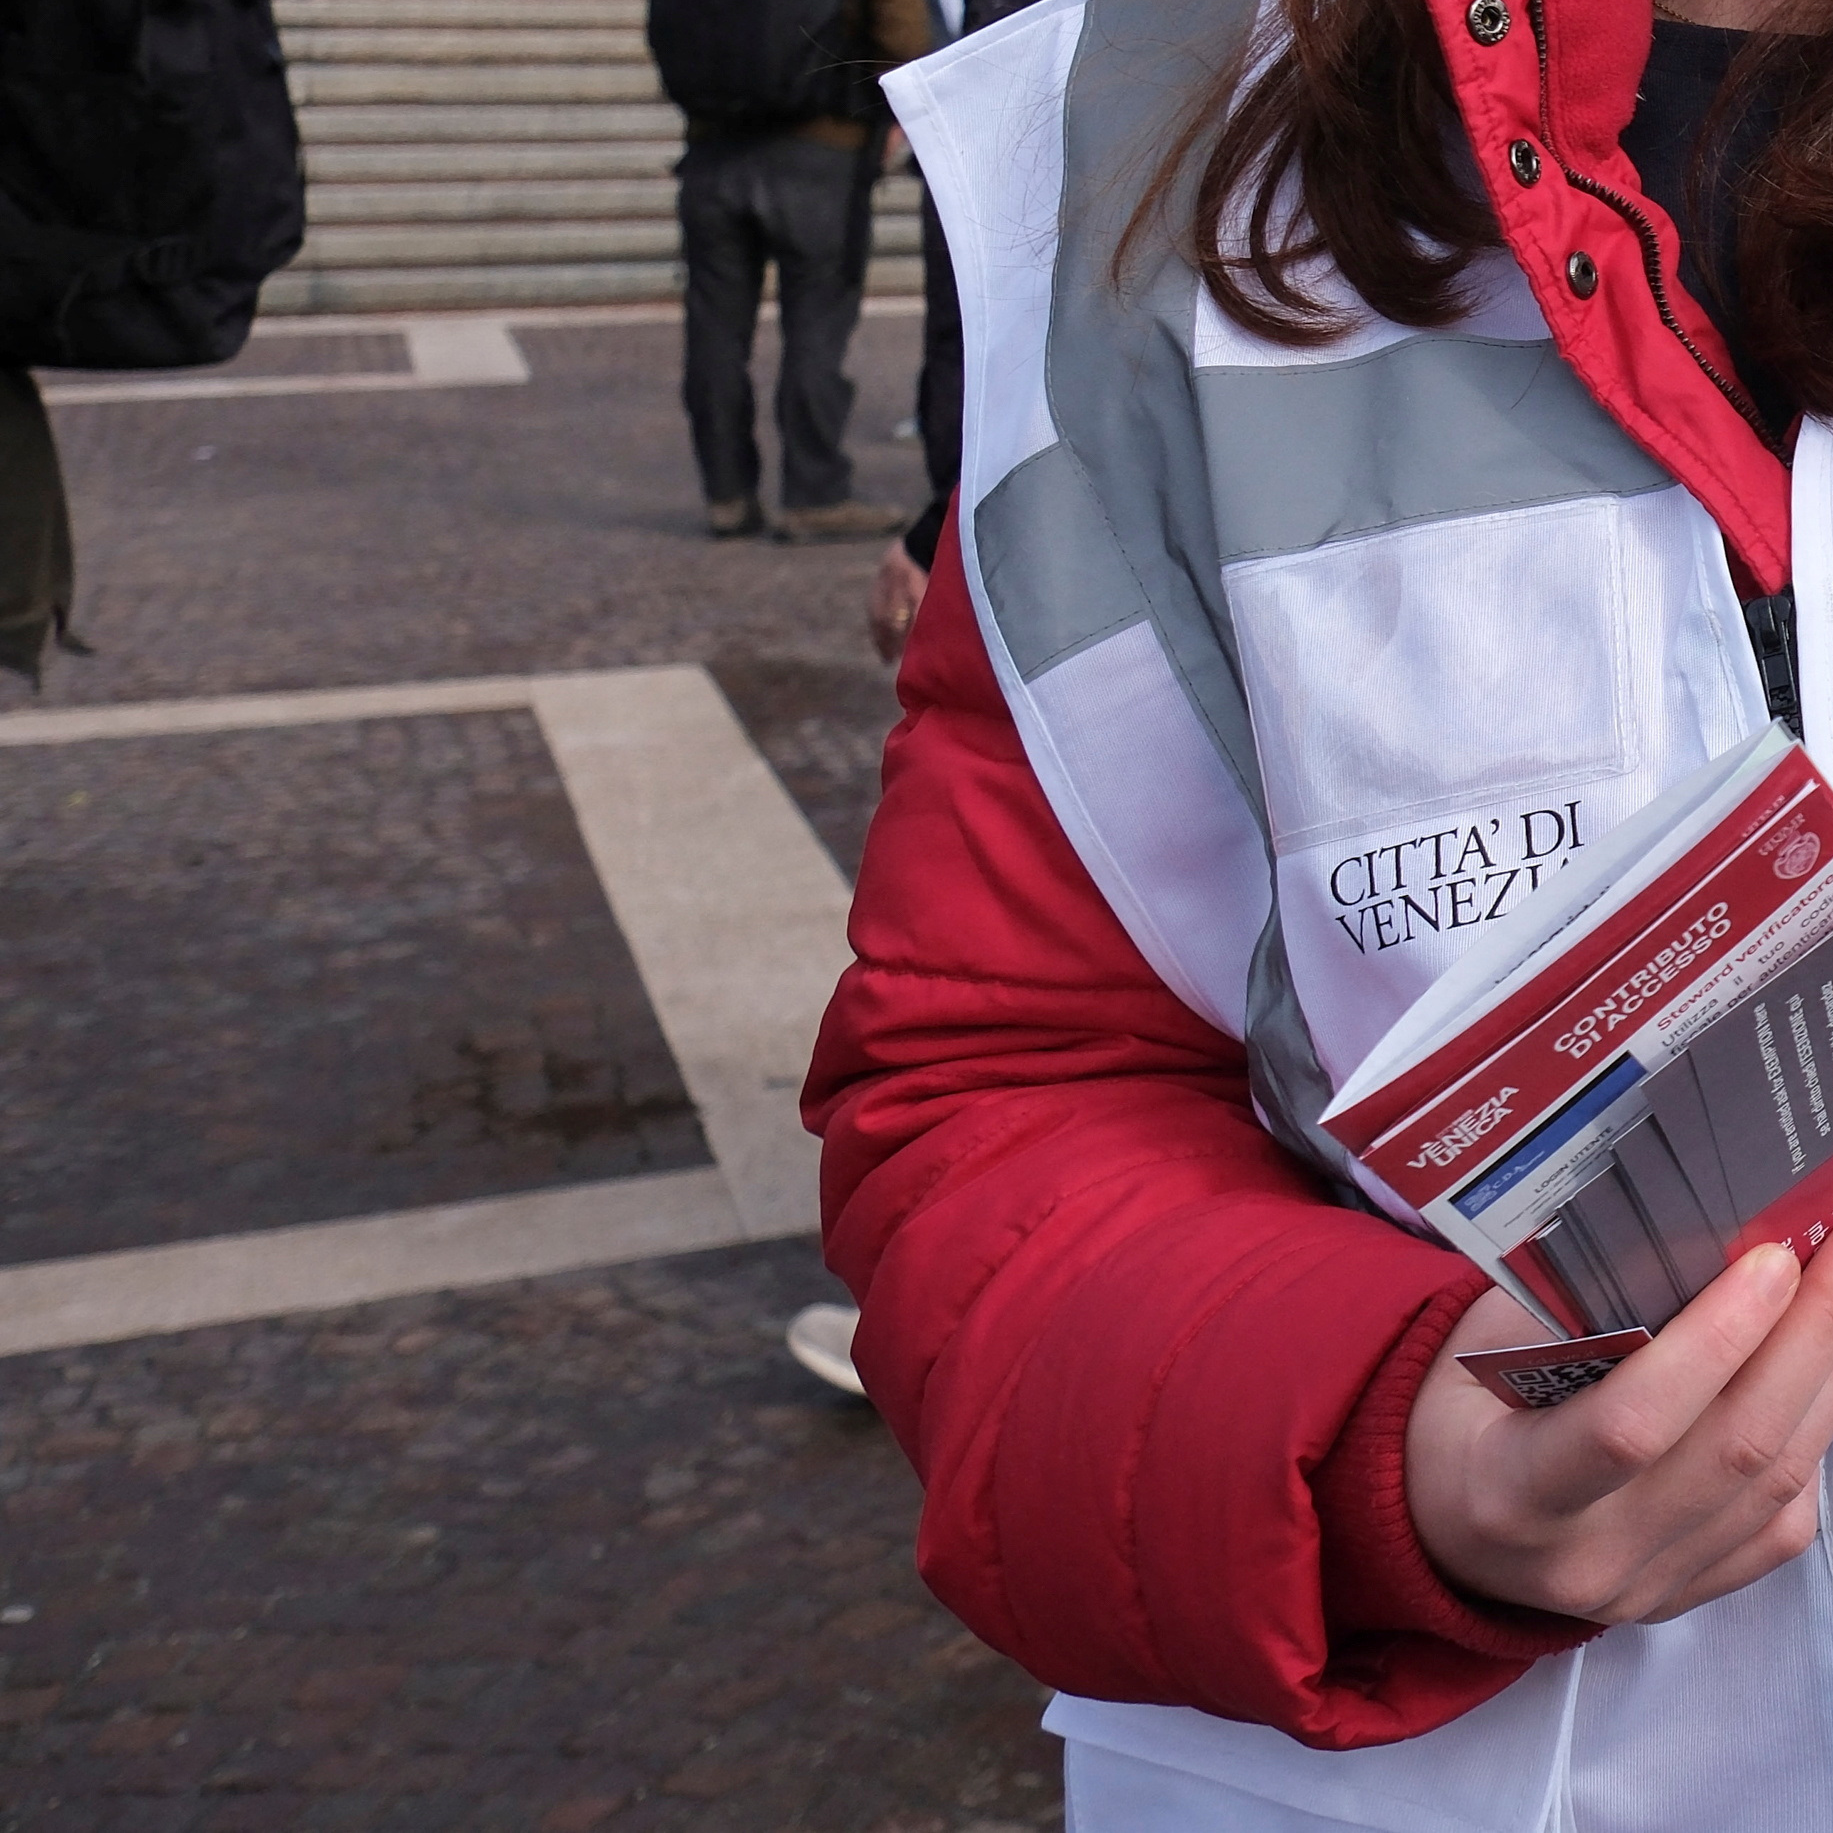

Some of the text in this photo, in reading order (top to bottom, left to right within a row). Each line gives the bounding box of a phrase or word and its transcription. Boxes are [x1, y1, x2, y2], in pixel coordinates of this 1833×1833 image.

[1330, 800, 1585, 907] CITTA' DI
[1335, 857, 1570, 955] VENEZI
[1554, 901, 1730, 1053] CONTRIBUTO
[1568, 1031, 1604, 1059] DI
[1606, 918, 1732, 1032] ACCESSO
[1657, 962, 1735, 1032] Steward
[1661, 997, 1719, 1048] Utilizza
[1733, 974, 1744, 986] il
[1757, 940, 1786, 965] tuo
[1433, 1107, 1514, 1167] UNICA
[1534, 1125, 1614, 1194] LOGIN UTENTE
